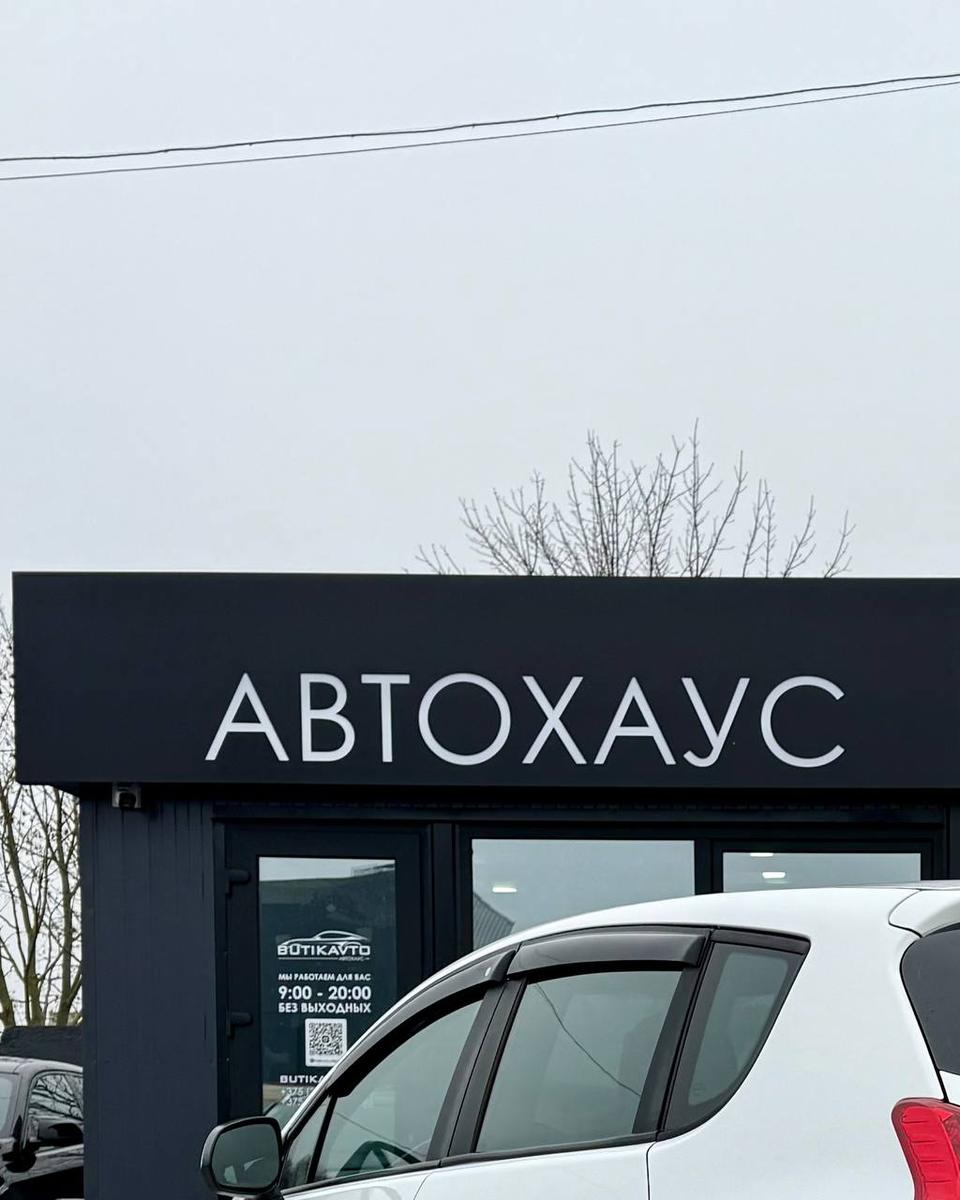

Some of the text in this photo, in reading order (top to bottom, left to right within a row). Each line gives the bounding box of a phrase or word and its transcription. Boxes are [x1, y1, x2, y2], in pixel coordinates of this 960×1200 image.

[205, 673, 845, 768] АВТОХАУС
[277, 945, 370, 956] BUTIKAVTO
[279, 973, 371, 982] МЫ РАБОТАЕМ ДЛЯ ВАС
[278, 985, 312, 1000] 9:00
[328, 985, 371, 1000] 20:00
[278, 1002, 371, 1014] БЕЗ ВЫХОДНЫХ
